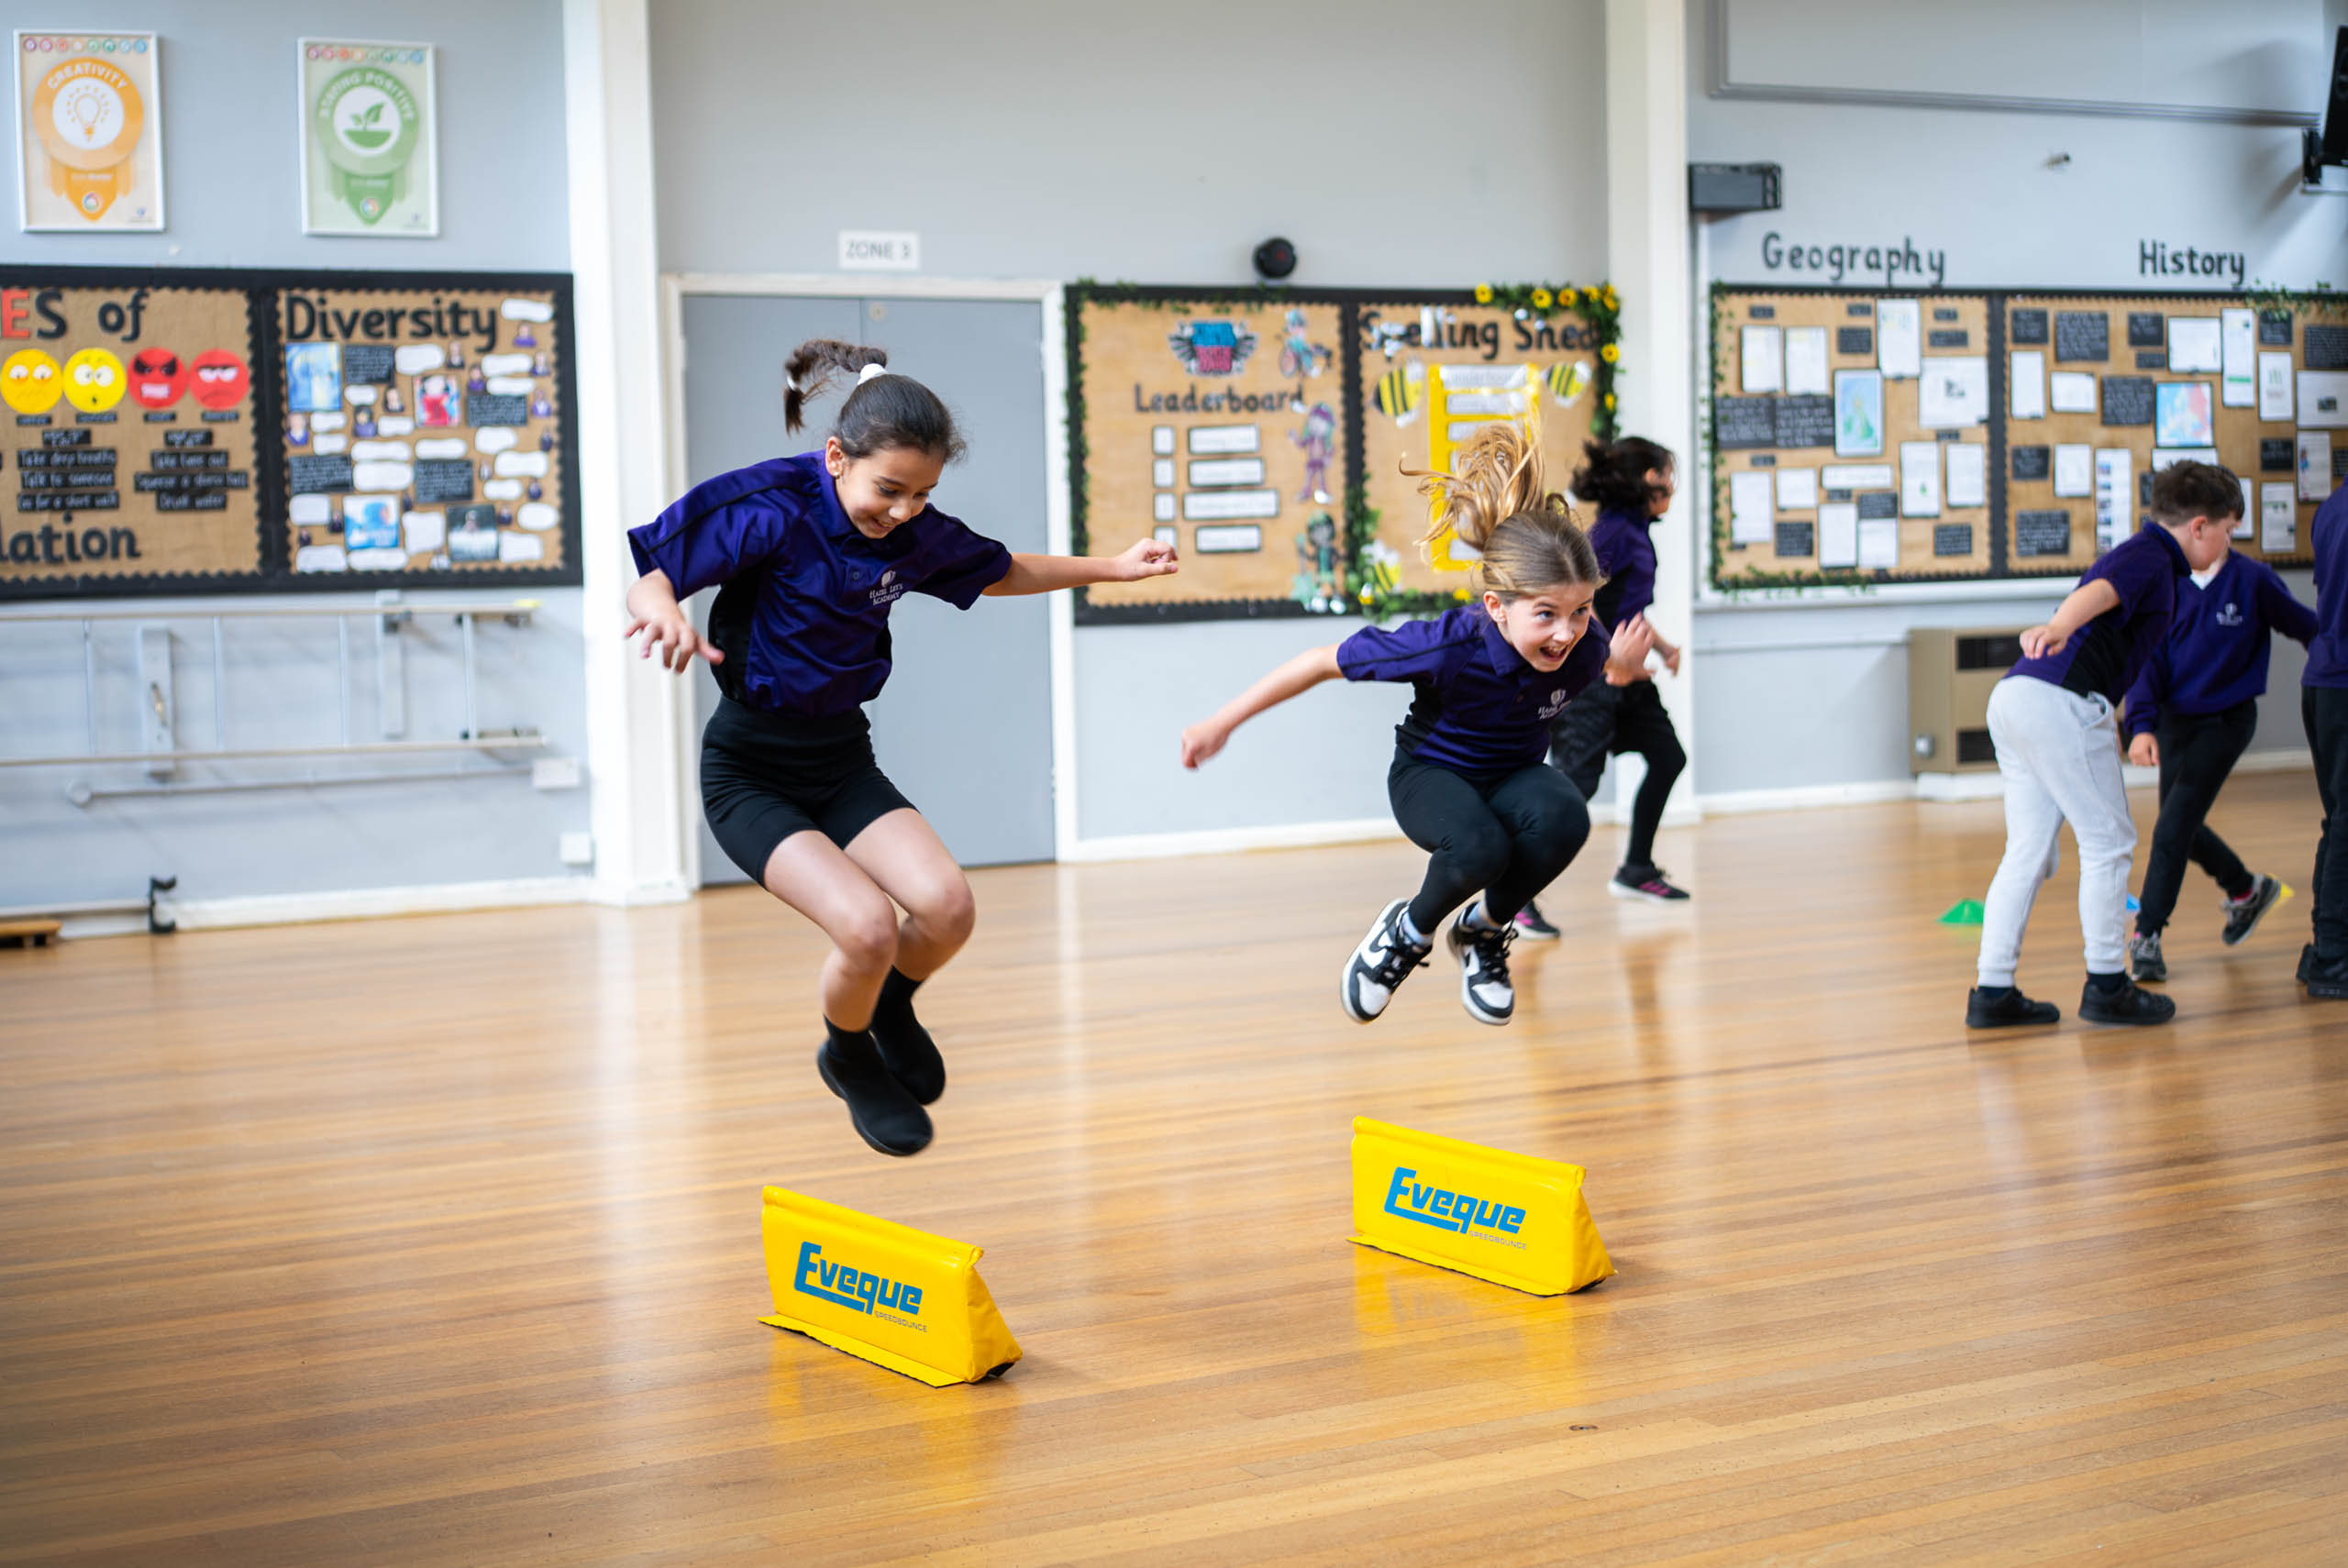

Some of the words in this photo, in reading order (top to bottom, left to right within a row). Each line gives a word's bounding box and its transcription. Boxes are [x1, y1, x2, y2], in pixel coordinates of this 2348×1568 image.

[48, 61, 127, 89] CREATIVITY
[845, 240, 894, 260] ZONE
[902, 241, 912, 260] 3
[1762, 231, 1944, 288] Geography
[2139, 239, 2245, 287] History
[97, 290, 150, 342] of
[284, 296, 497, 353] Diversity
[873, 591, 900, 605] ACADEMY
[1384, 1166, 1526, 1234] Eveque
[1469, 1230, 1527, 1251] SPEEDBOUNCE
[793, 1241, 923, 1315] Eveque
[874, 1310, 928, 1332] SPEEDBOUNCE
